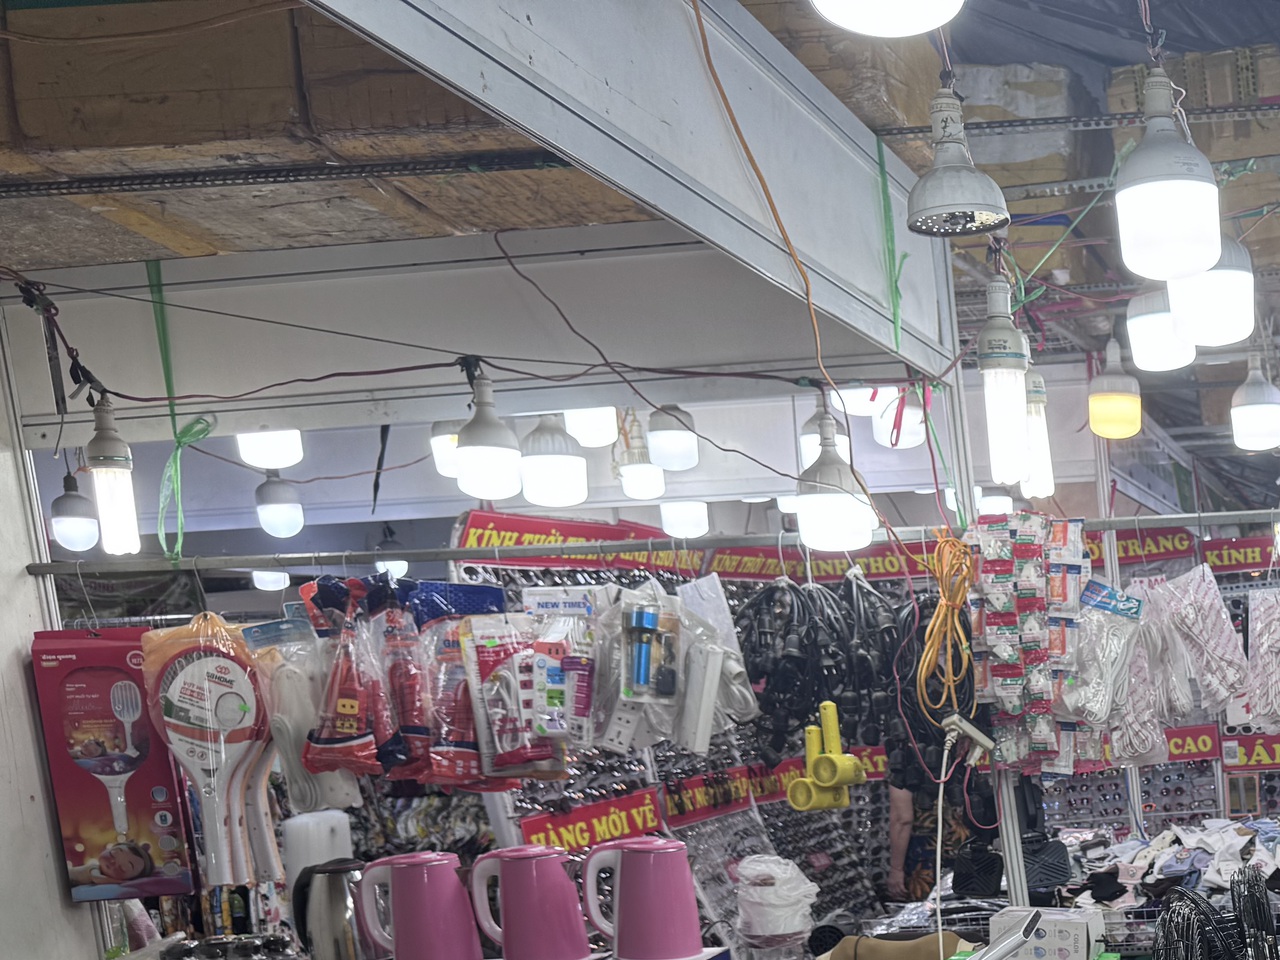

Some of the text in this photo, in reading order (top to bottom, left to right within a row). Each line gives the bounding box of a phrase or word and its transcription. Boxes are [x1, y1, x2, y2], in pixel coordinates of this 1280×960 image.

[1117, 532, 1191, 558] TRANG
[1204, 544, 1262, 567] KÍNH
[854, 550, 908, 576] THỜI
[537, 601, 588, 610] NEW TIMES
[1169, 735, 1213, 756] CAO
[530, 821, 590, 851] HÀNG
[591, 806, 631, 843] MỚI
[630, 794, 659, 828] VỀ
